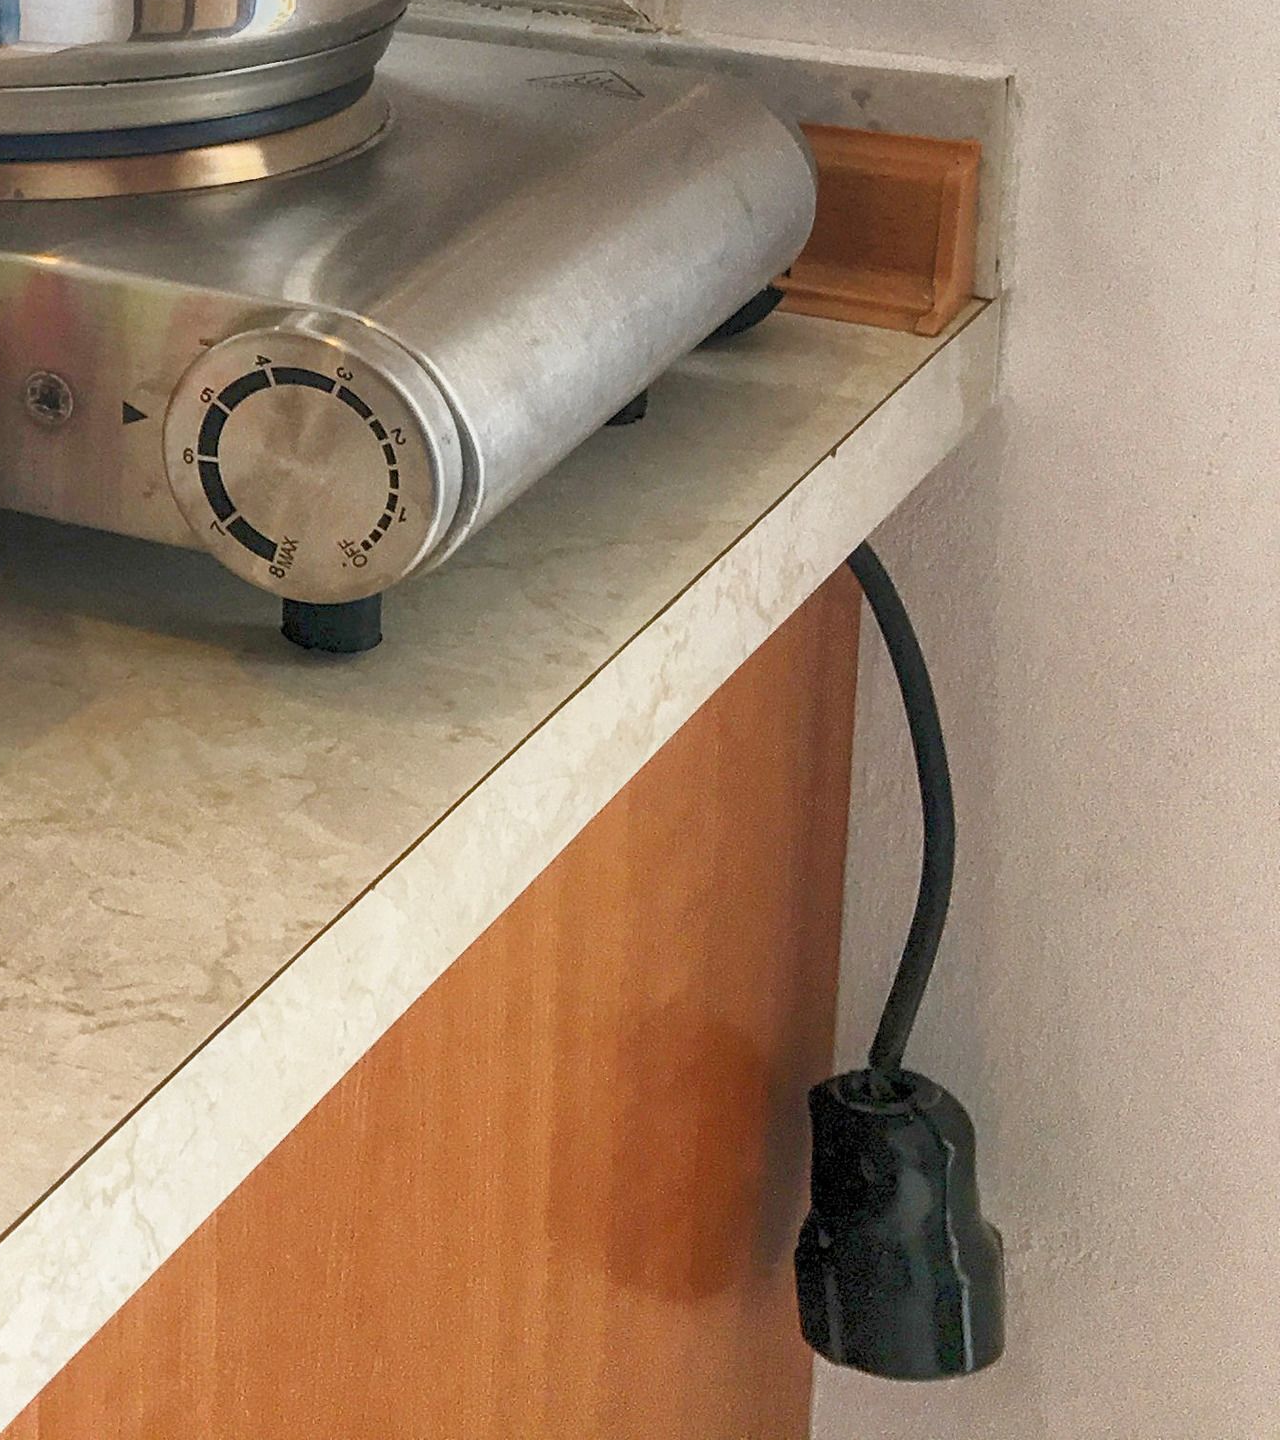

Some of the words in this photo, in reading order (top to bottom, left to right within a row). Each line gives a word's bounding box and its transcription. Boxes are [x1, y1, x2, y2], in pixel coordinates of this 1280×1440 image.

[255, 354, 272, 368] 4
[335, 366, 354, 382] 3
[199, 386, 215, 404] 5
[390, 427, 407, 446] 2
[278, 535, 299, 570] MAX
[337, 538, 369, 569] OFF
[268, 564, 286, 579] 8
